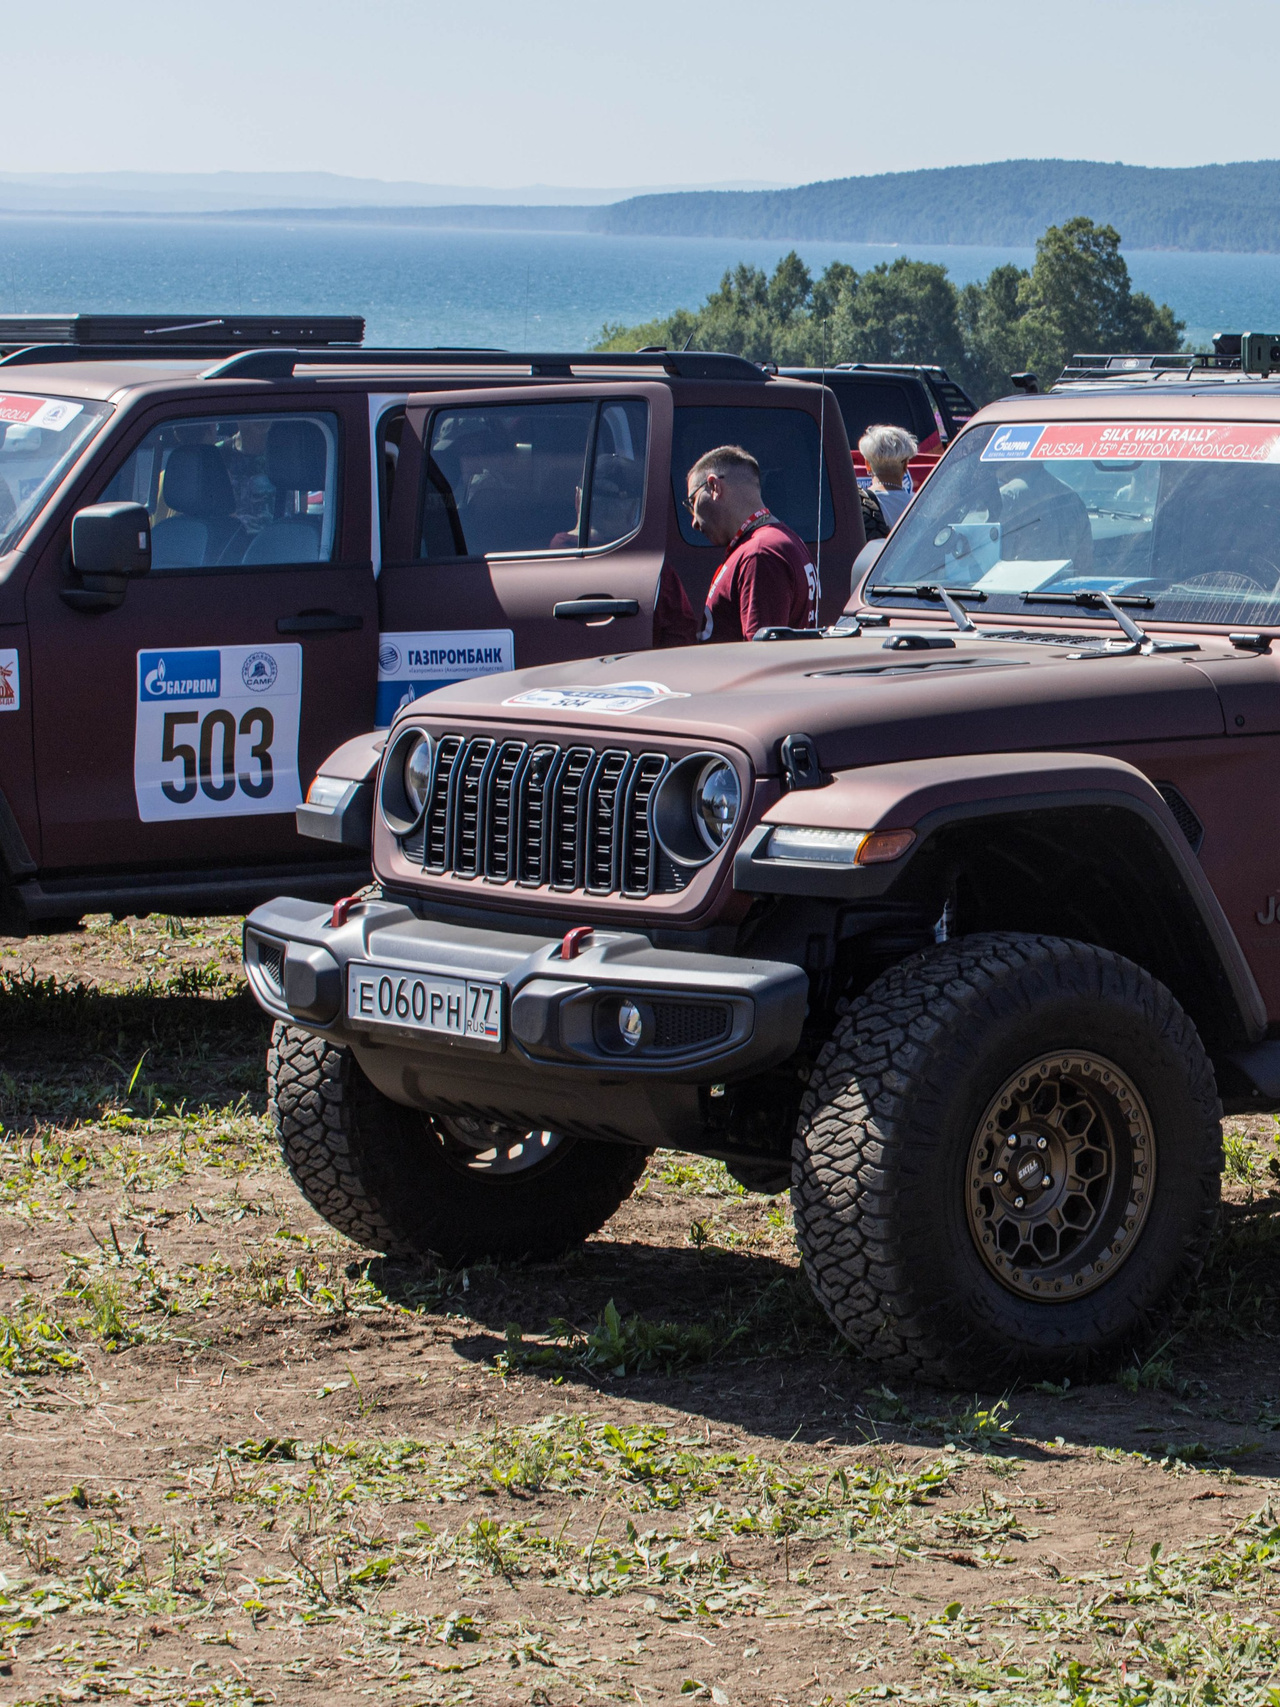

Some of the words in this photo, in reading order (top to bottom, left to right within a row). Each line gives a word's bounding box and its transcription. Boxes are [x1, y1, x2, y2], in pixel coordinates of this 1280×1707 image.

[1099, 429, 1133, 441] SILK
[1133, 429, 1169, 441] WAY
[1167, 429, 1217, 441] RALLY
[1002, 441, 1031, 451] GAZPROM
[1036, 443, 1083, 456] RUSSIA
[1117, 443, 1175, 457] EDITION
[1188, 443, 1265, 457] MONGOLIA
[407, 648, 503, 666] ГАЗПРОМБАНК
[166, 679, 217, 695] GAZPROM
[246, 679, 273, 687] CAMF
[552, 699, 591, 707] 504
[161, 706, 275, 804] 503
[360, 975, 461, 1028] Е060РН
[468, 984, 494, 1021] 77
[466, 1019, 485, 1034] RUS
[1018, 1159, 1039, 1180] SKILL
